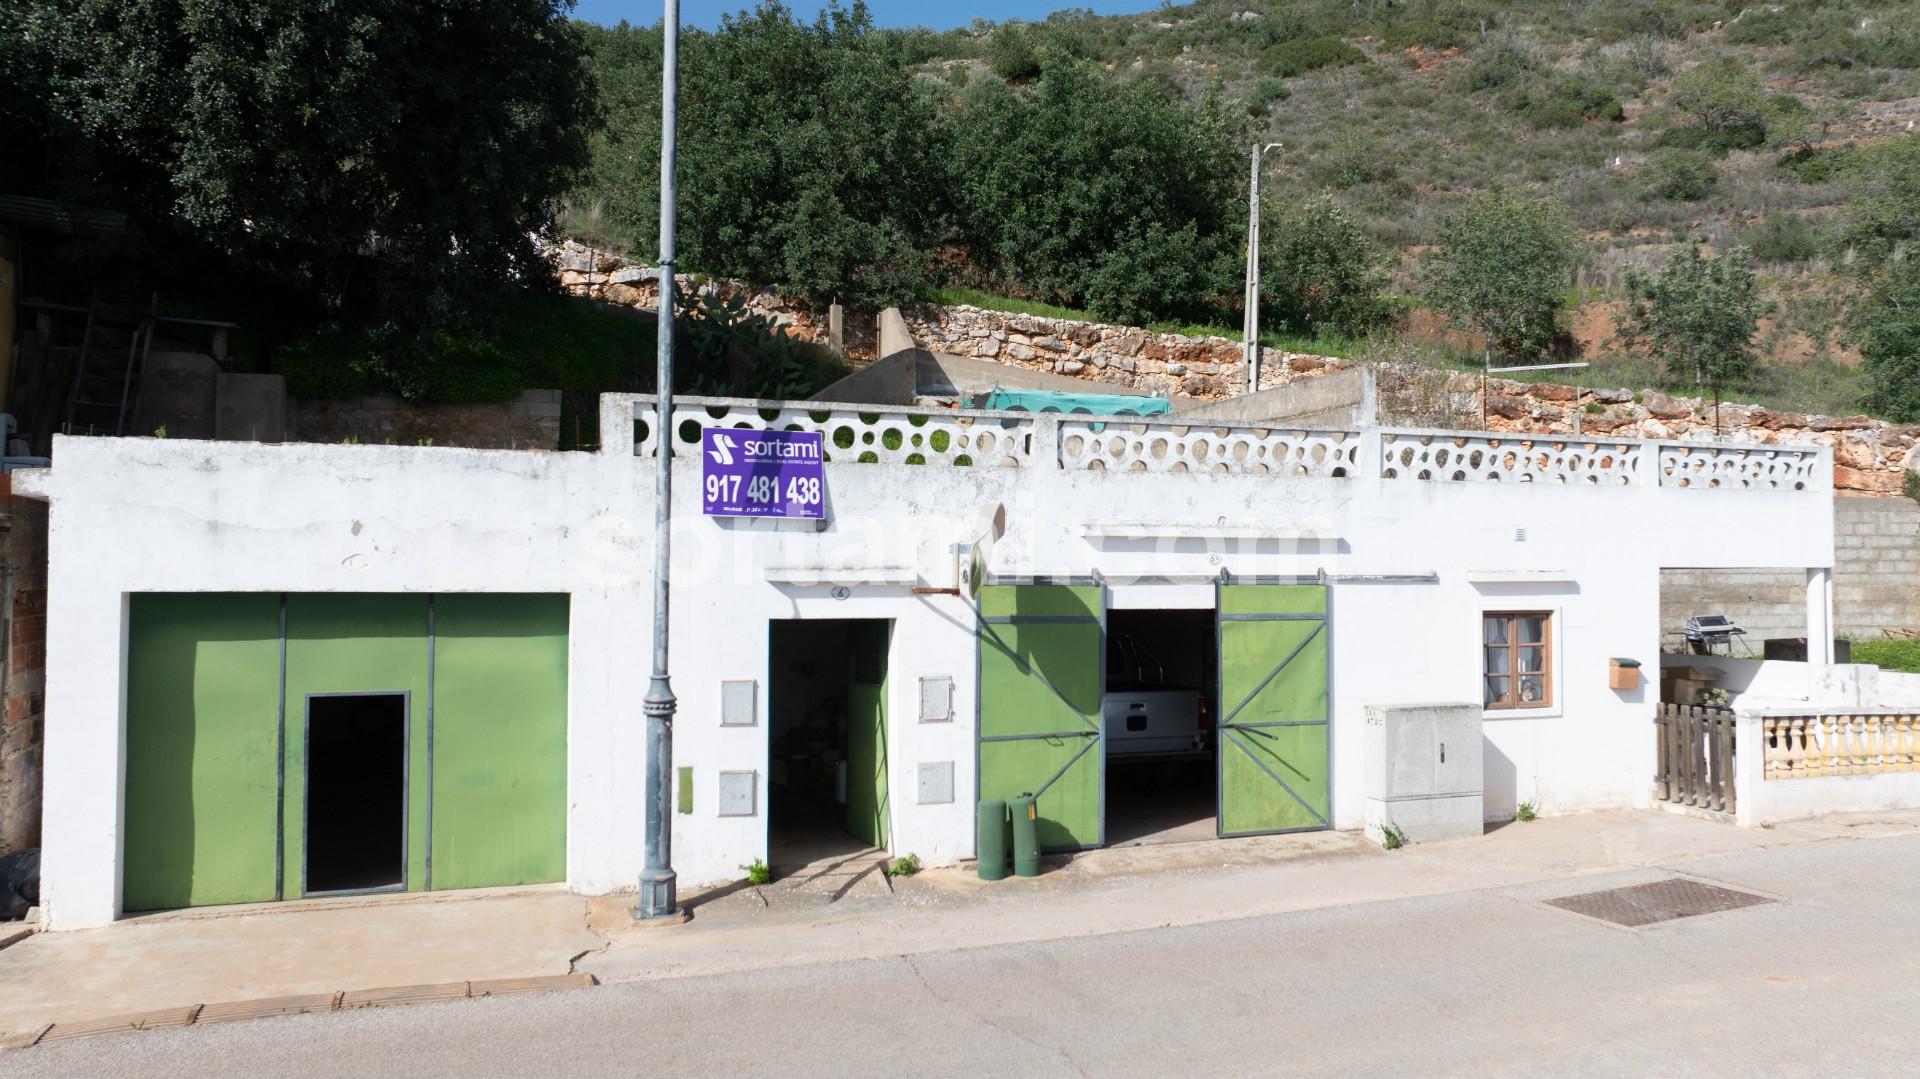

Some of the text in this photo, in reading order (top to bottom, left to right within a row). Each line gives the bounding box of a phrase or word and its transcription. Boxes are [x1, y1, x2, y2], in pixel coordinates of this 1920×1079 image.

[744, 439, 819, 458] sortami
[707, 474, 821, 505] 917 481 438
